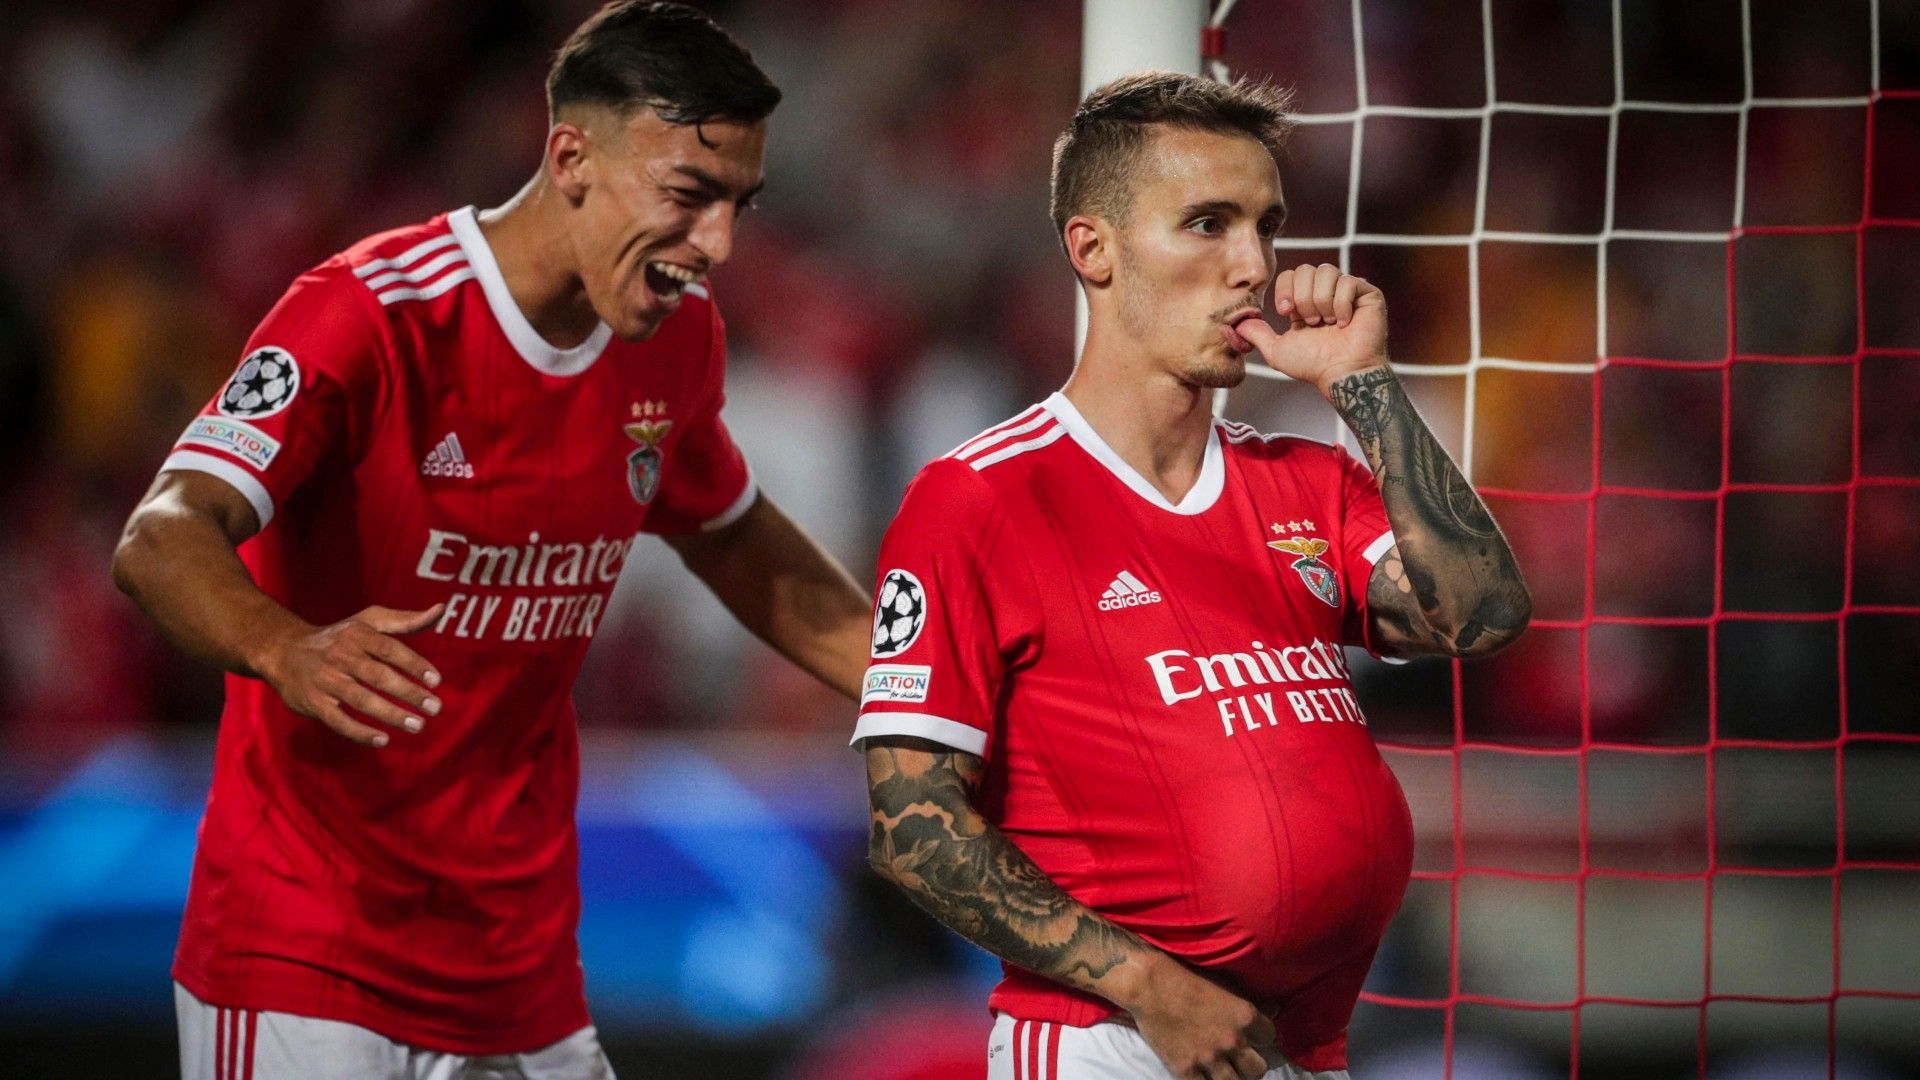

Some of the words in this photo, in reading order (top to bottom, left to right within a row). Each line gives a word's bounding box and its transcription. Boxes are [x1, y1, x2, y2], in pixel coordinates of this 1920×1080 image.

[421, 460, 475, 479] adidas
[435, 593, 502, 639] FLY
[502, 593, 603, 641] BETTER
[1098, 591, 1162, 611] adidas
[1145, 636, 1350, 705] Emirate
[1217, 692, 1278, 737] FLY
